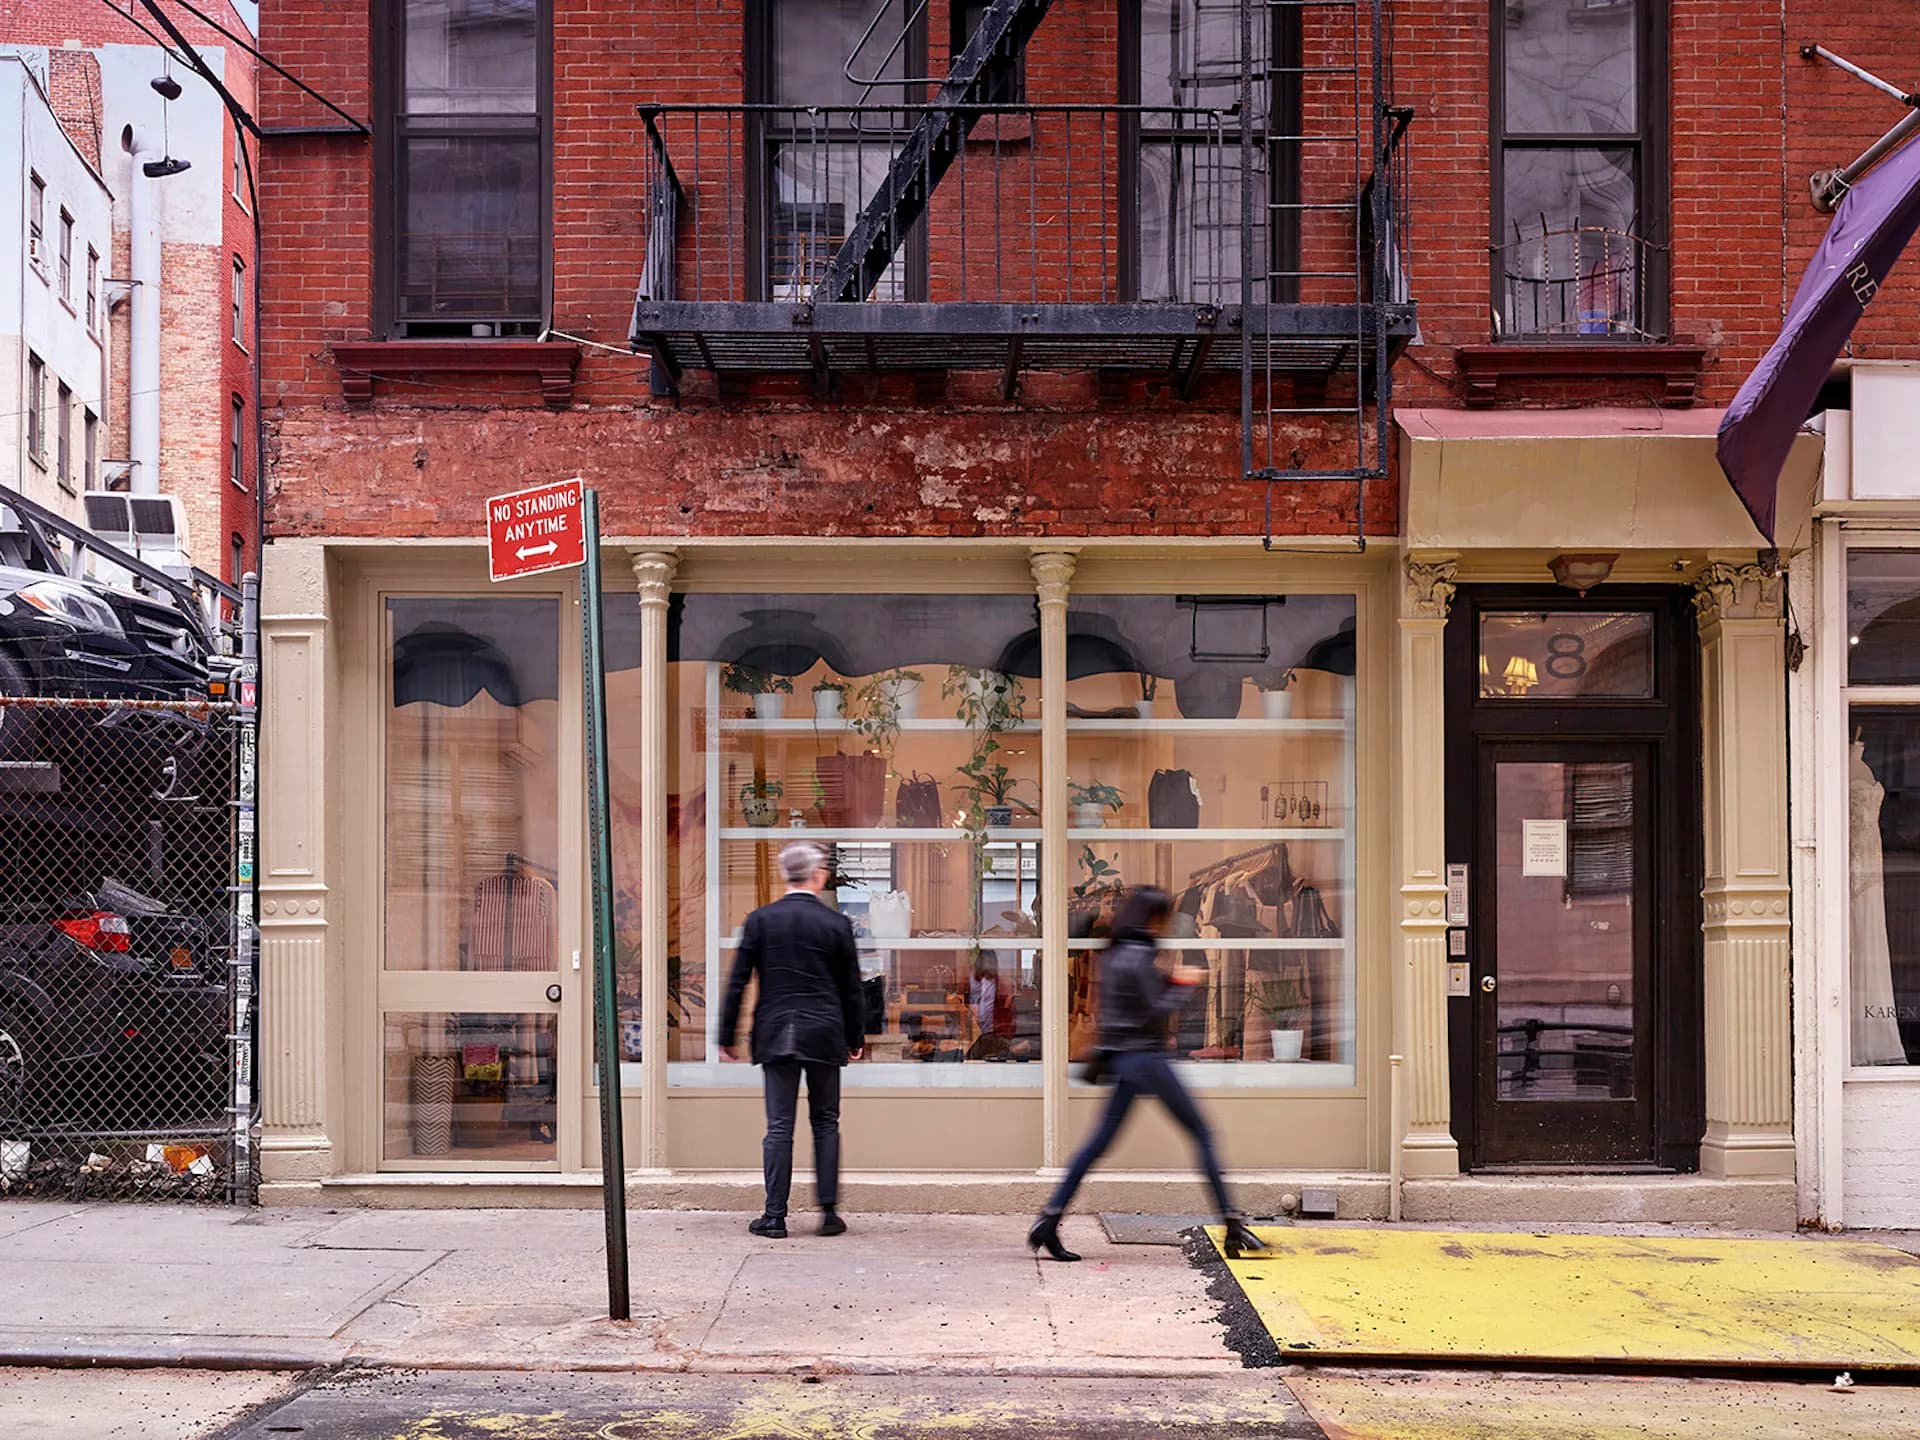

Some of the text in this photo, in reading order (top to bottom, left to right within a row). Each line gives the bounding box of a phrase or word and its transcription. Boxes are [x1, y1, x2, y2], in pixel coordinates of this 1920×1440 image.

[494, 490, 576, 523] NO STANDING
[505, 514, 568, 542] ANYTIME
[1546, 633, 1586, 678] 8
[1864, 1005, 1917, 1019] KAREN
